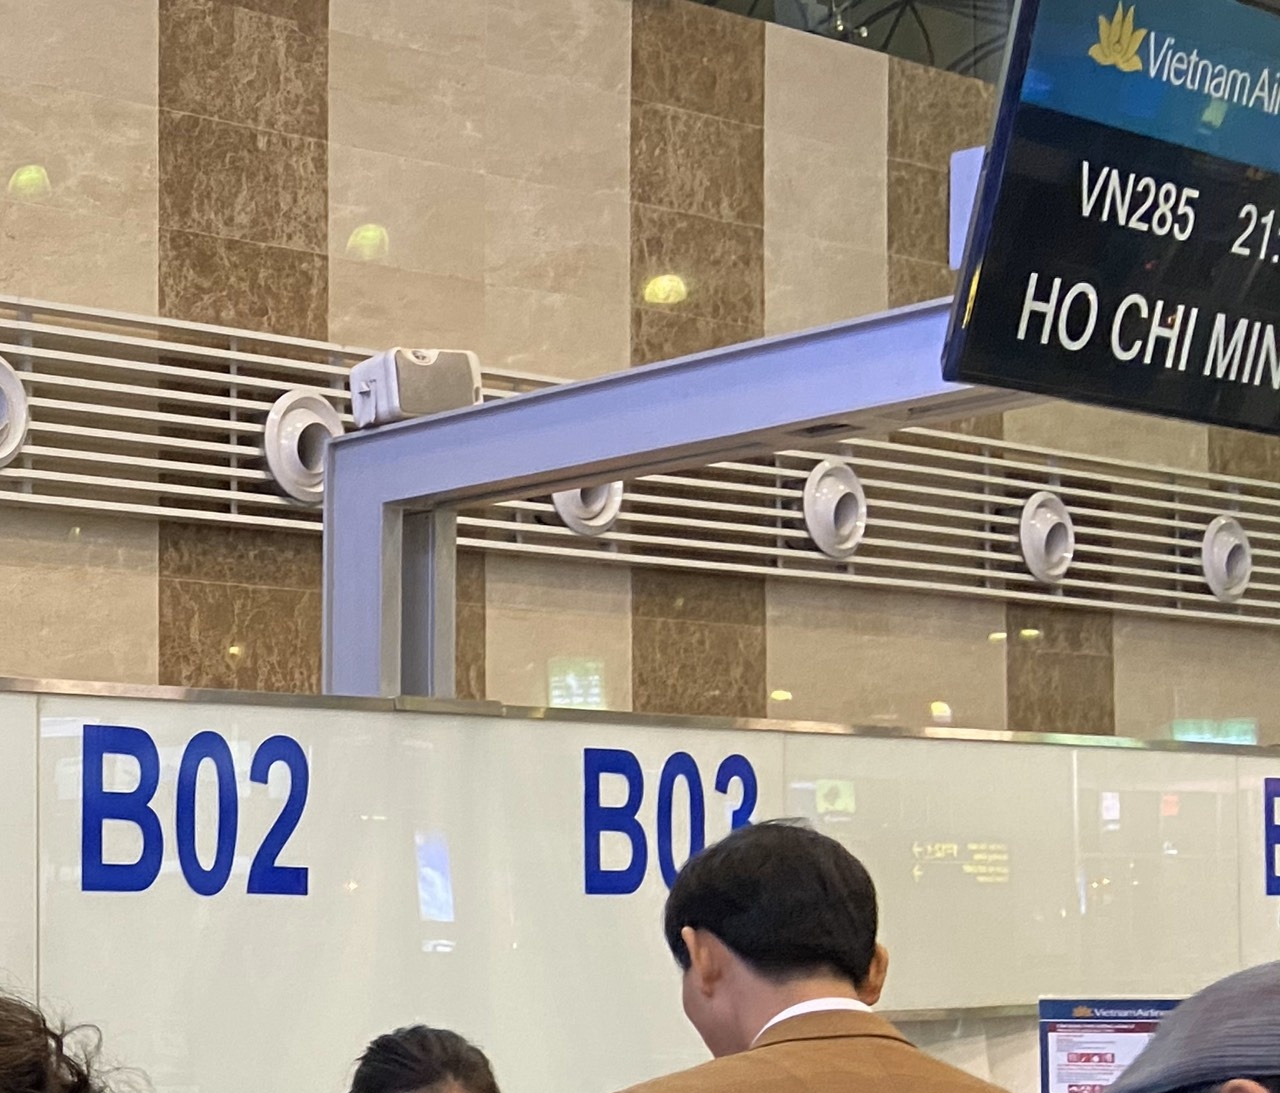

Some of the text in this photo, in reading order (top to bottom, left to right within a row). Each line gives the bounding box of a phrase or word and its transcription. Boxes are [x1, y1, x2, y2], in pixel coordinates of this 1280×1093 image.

[1081, 160, 1200, 241] VN285
[1017, 272, 1280, 390] HO CHI MIN
[81, 724, 310, 897] B02
